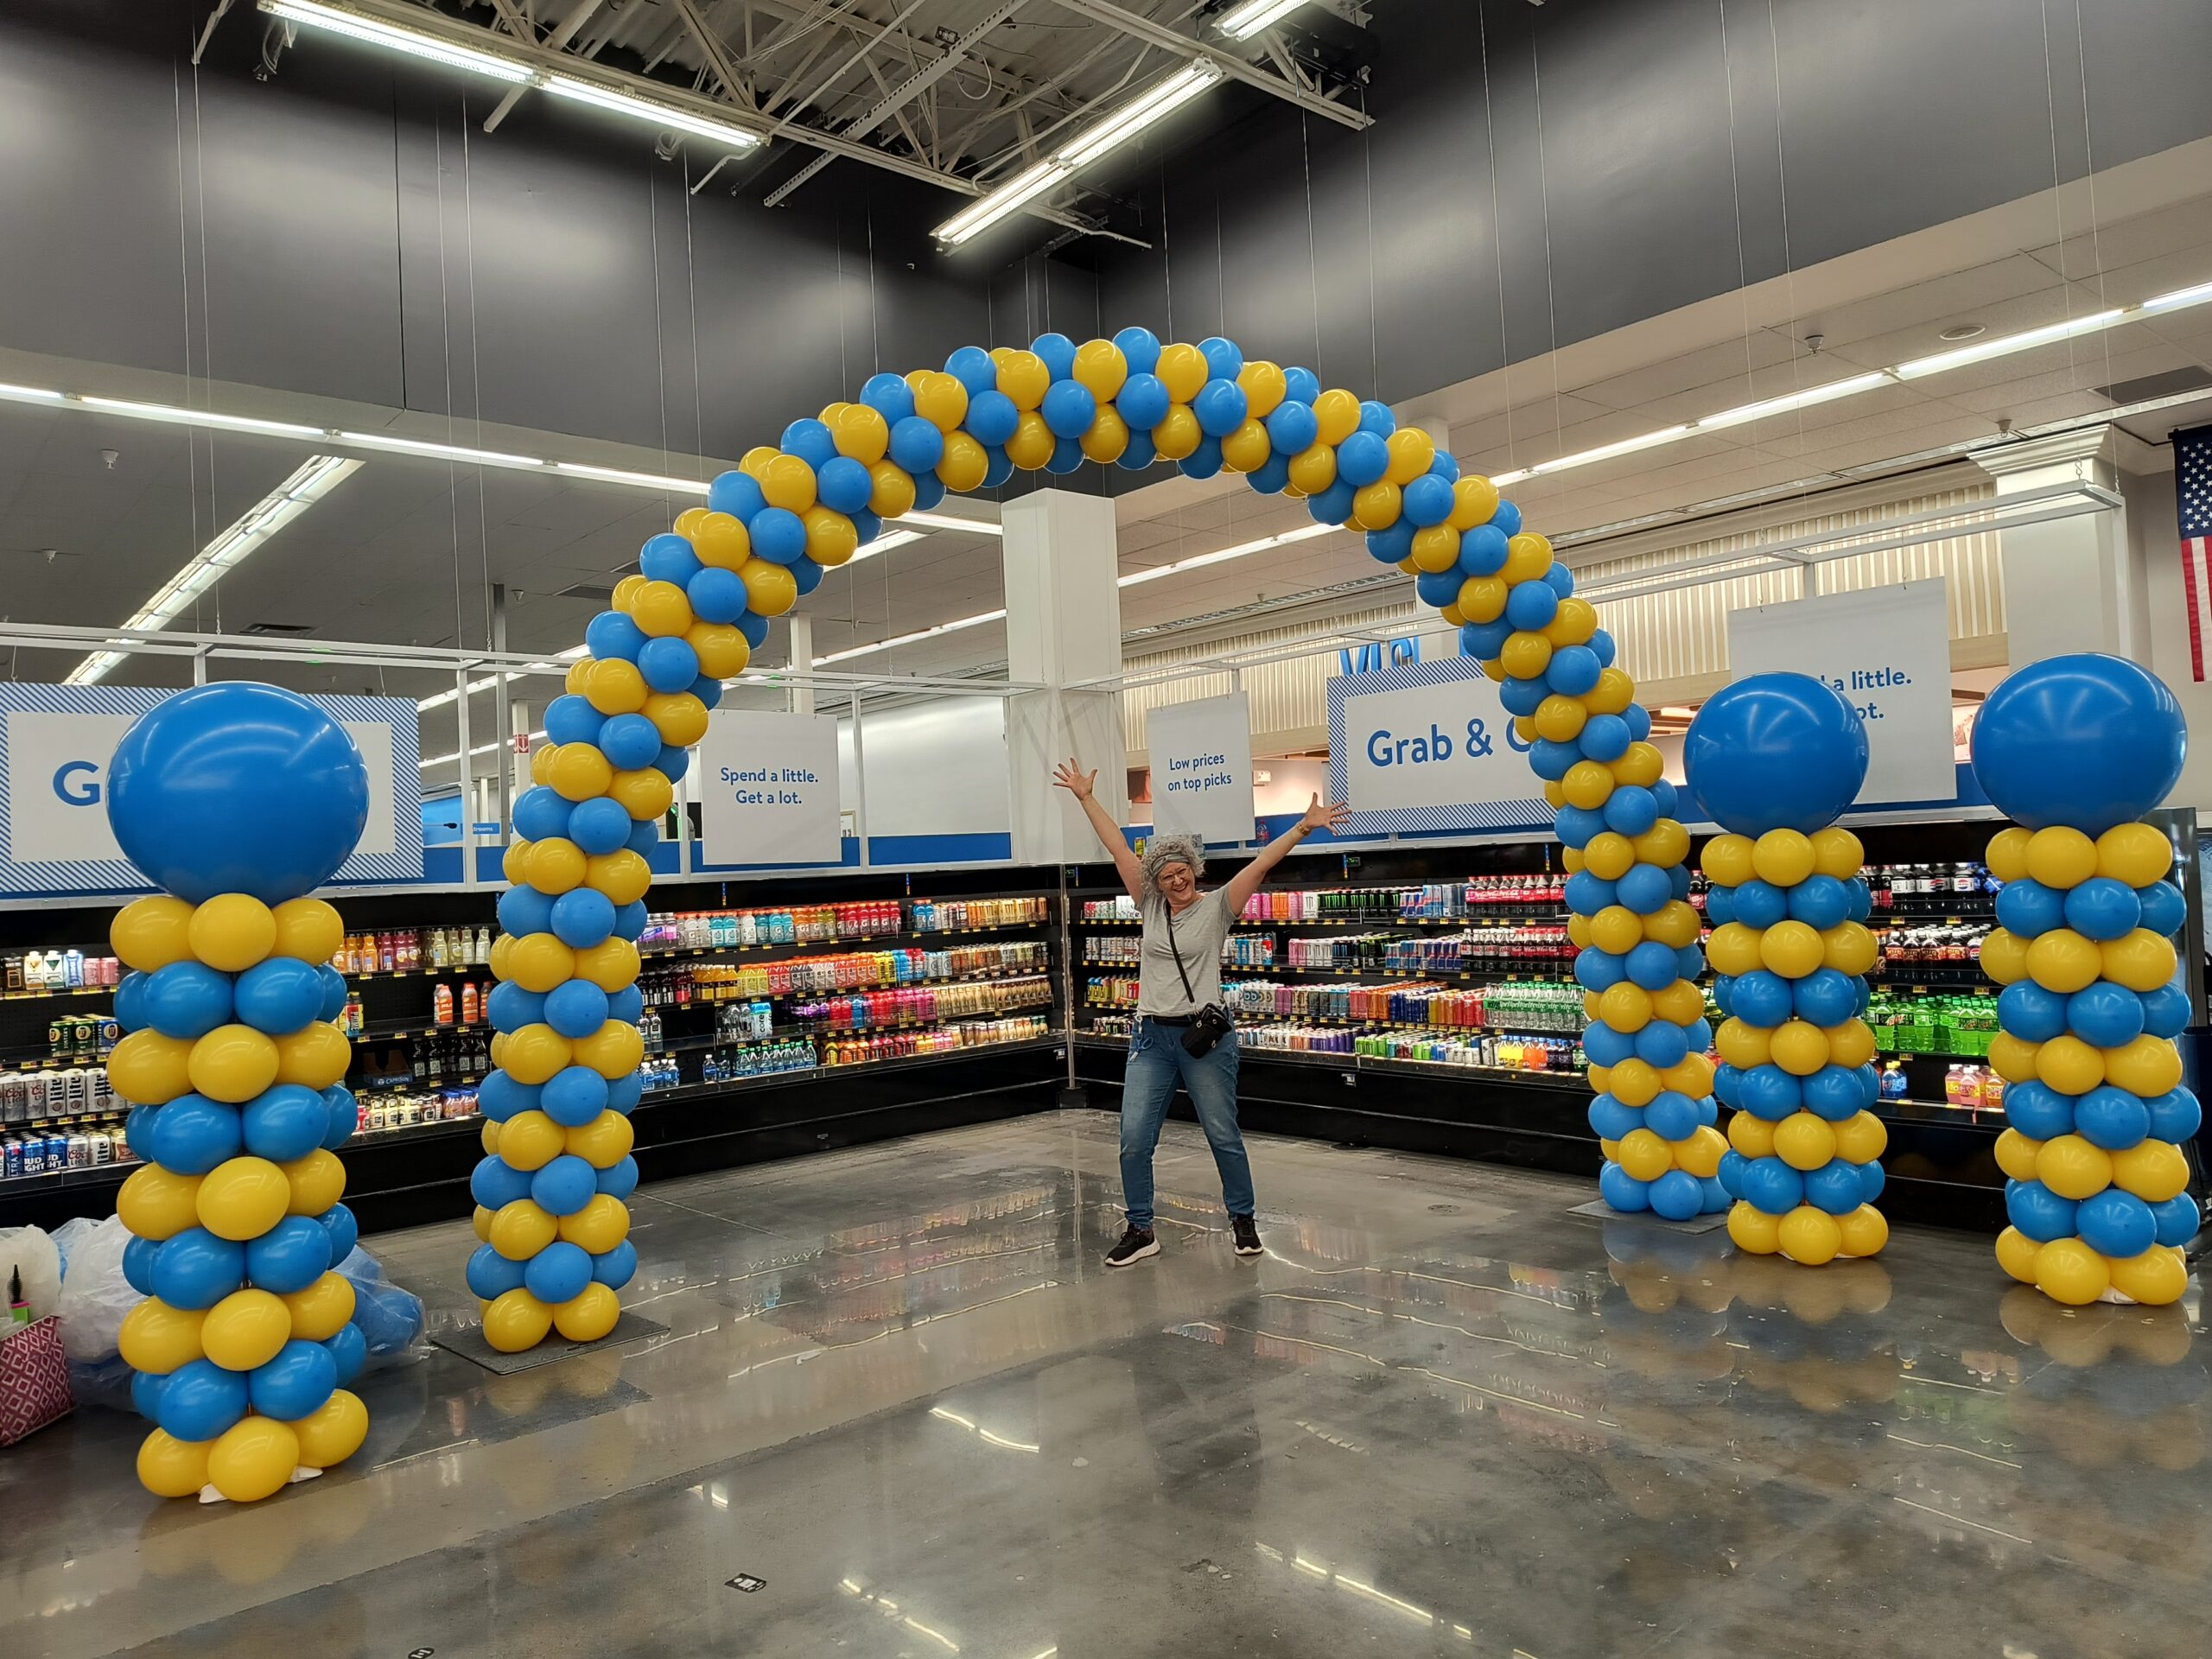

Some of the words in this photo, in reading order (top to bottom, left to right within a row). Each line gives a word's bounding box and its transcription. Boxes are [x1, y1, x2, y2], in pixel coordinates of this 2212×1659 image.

[1852, 667, 1912, 690] little.
[1367, 723, 1452, 767] Grab
[1465, 718, 1494, 758] &
[1169, 758, 1190, 771] Low
[1193, 753, 1225, 772] prices
[721, 767, 766, 786] Spend
[770, 772, 779, 782] a
[782, 768, 818, 783] little.
[1168, 781, 1180, 791] on
[1184, 779, 1201, 792] top
[1205, 772, 1232, 791] picks
[735, 790, 763, 804] Get
[767, 794, 774, 804] a
[779, 790, 802, 804] lot.
